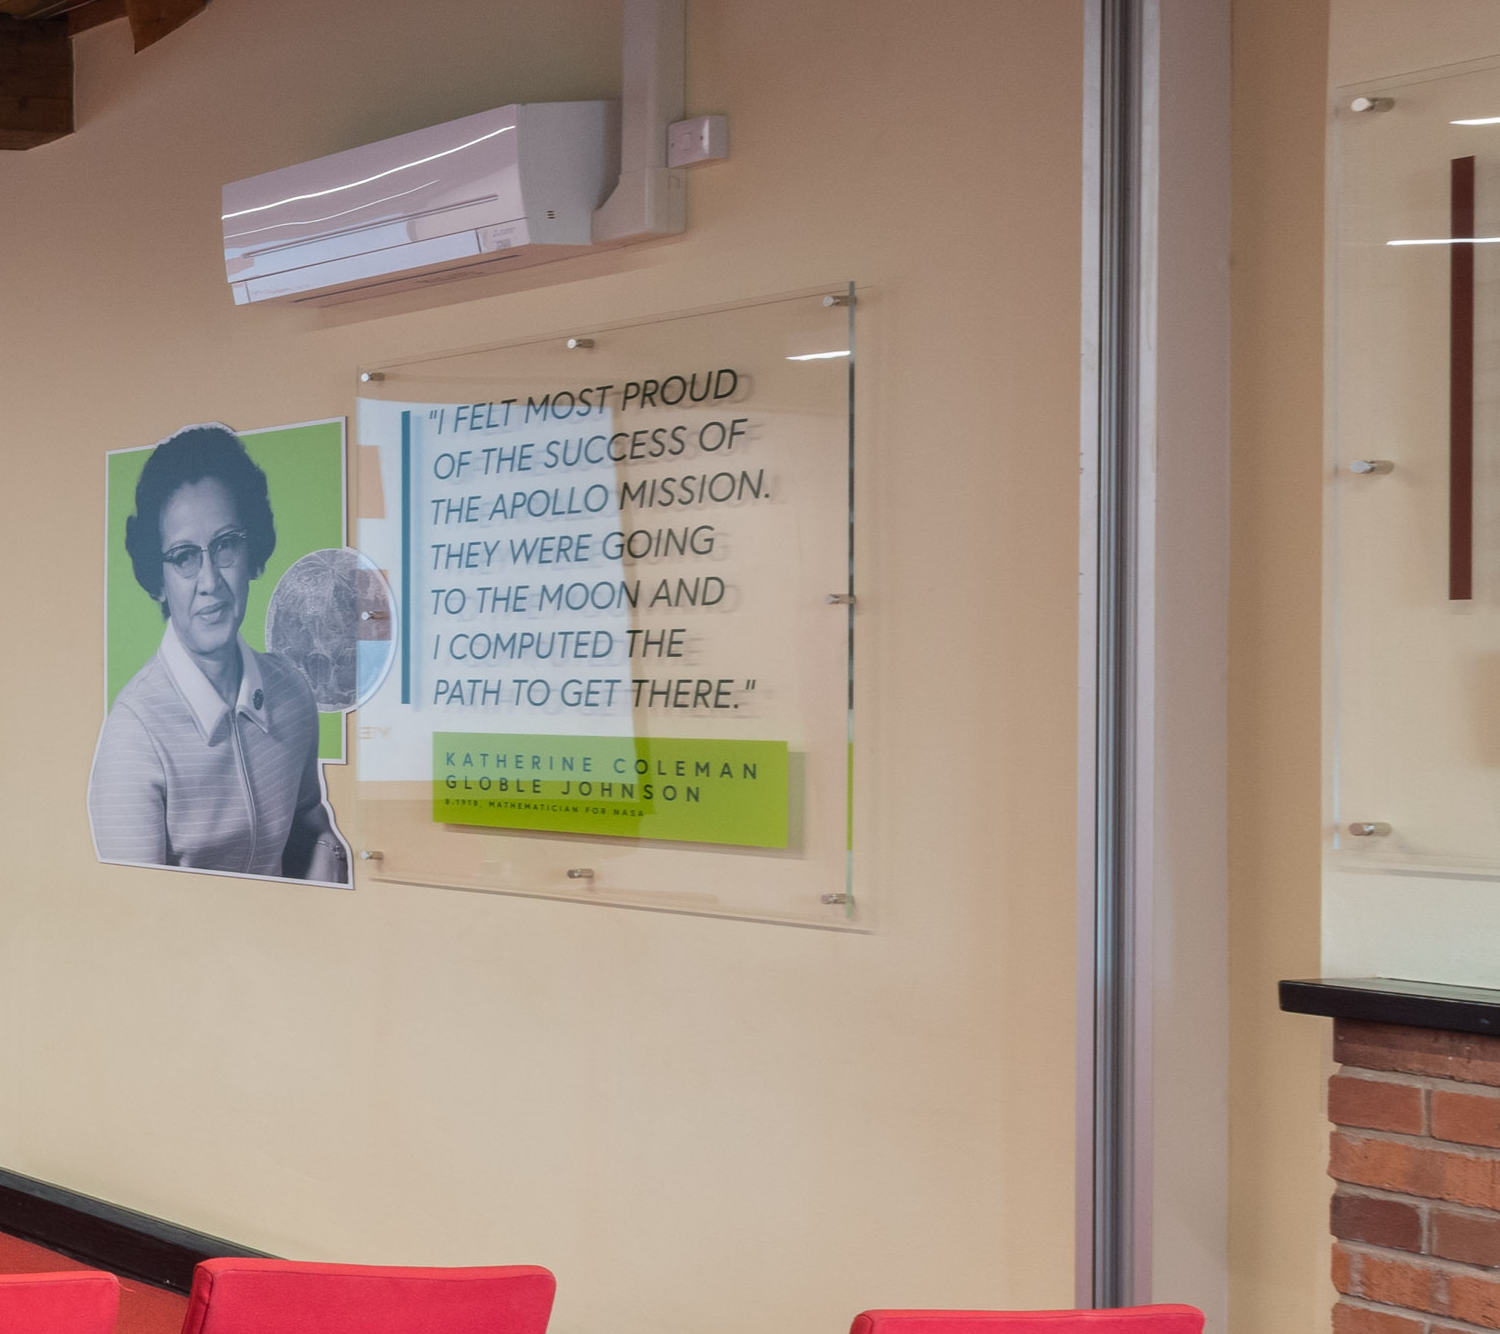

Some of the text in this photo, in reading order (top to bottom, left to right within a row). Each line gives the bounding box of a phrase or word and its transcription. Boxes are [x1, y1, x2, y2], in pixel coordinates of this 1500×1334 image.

[453, 399, 518, 432] FELT
[524, 384, 614, 423] MOST
[621, 368, 739, 411] PROUD
[433, 418, 749, 479] OF THE SUCCESS OF
[431, 468, 771, 525] THE APOLLO MISSION.
[431, 525, 716, 570] THEY WERE GOING
[431, 576, 725, 615] TO THE MOON AND
[433, 628, 687, 660] I COMPUTED THE
[433, 678, 757, 709] PATH TO GET THERE."
[445, 752, 758, 780] KATHERINE COLEMAN
[445, 774, 701, 802] GLOBLE JOHNSON
[488, 800, 579, 814] MATHEMATICIAN
[584, 806, 607, 815] FOR
[613, 808, 645, 818] NASA
